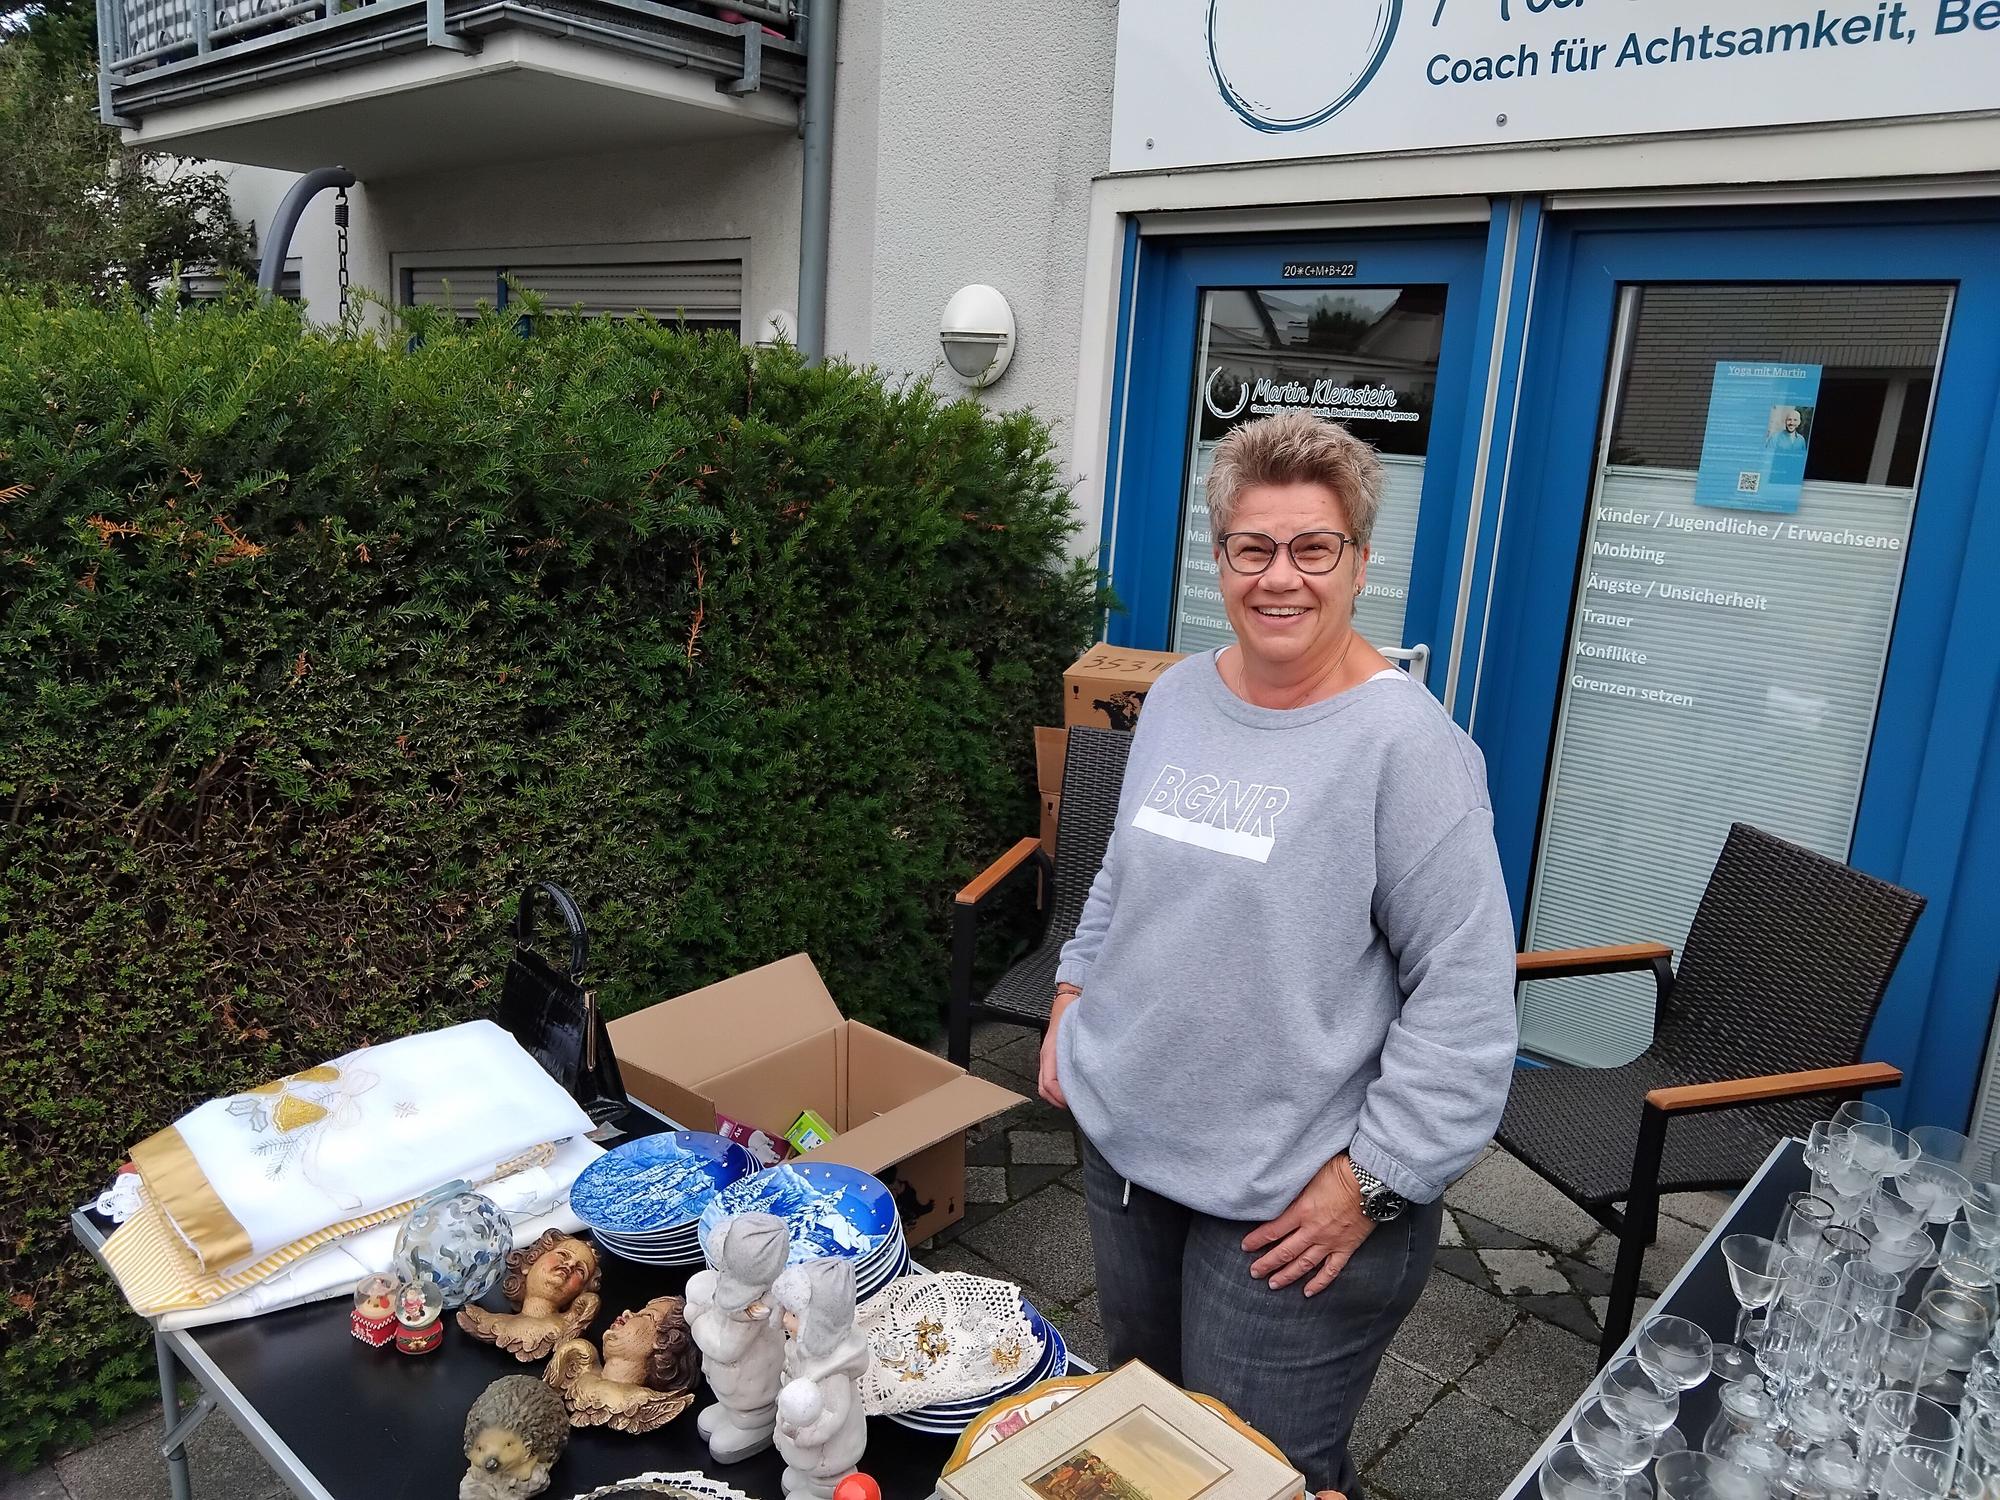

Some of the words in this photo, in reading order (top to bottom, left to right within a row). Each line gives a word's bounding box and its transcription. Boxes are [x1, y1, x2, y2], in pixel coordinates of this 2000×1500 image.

[1426, 44, 1539, 86] Coach
[1551, 38, 1607, 74] für
[1614, 3, 1917, 68] Achtsamkeit,
[1729, 366, 1752, 376] Yoga
[1754, 367, 1769, 377] mit
[1773, 368, 1807, 379] Martin
[1252, 378, 1310, 403] Martin
[1311, 379, 1397, 408] Klemstein
[1251, 404, 1273, 414] Coach
[1331, 408, 1376, 419] Bedürfnisse
[1377, 410, 1384, 419] &
[1384, 410, 1420, 421] Hypnose
[1597, 507, 1650, 526] Kinder
[1666, 513, 1769, 537] Jugendliche
[1787, 525, 1900, 550] Erwachsene
[1593, 541, 1666, 565] Mobbing
[1587, 572, 1642, 594] Ängste
[1659, 583, 1767, 610] Unsicherheit
[1182, 612, 1223, 629] Termine
[1583, 609, 1634, 628] Trauer
[1576, 641, 1647, 665] Konflikte
[1571, 675, 1636, 697] Grenzen
[1640, 688, 1693, 707] setzen
[1143, 764, 1290, 839] BGNR
